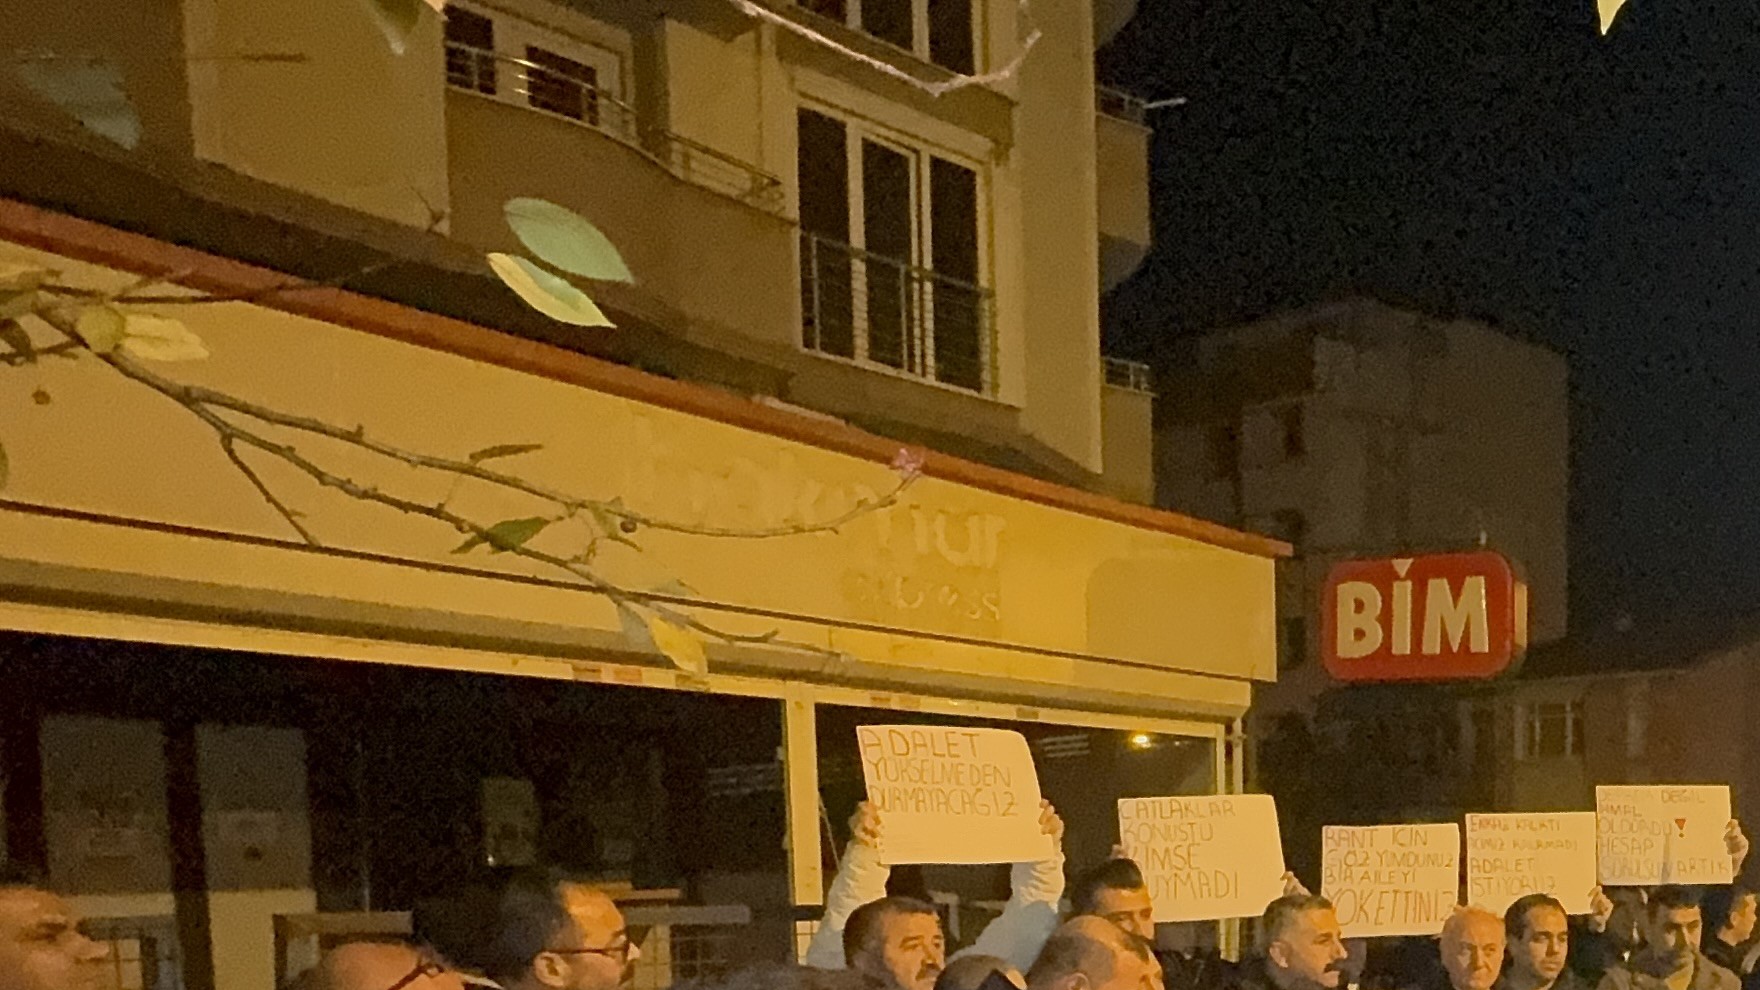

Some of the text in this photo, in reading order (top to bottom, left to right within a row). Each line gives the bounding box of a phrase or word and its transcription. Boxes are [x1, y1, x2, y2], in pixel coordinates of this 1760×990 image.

[1336, 558, 1489, 659] BİM
[860, 729, 980, 758] ADALET
[1325, 827, 1379, 848] RANT
[1599, 837, 1655, 856] HESAP
[1470, 857, 1535, 874] ADALET
[1146, 870, 1239, 901] UYMADI
